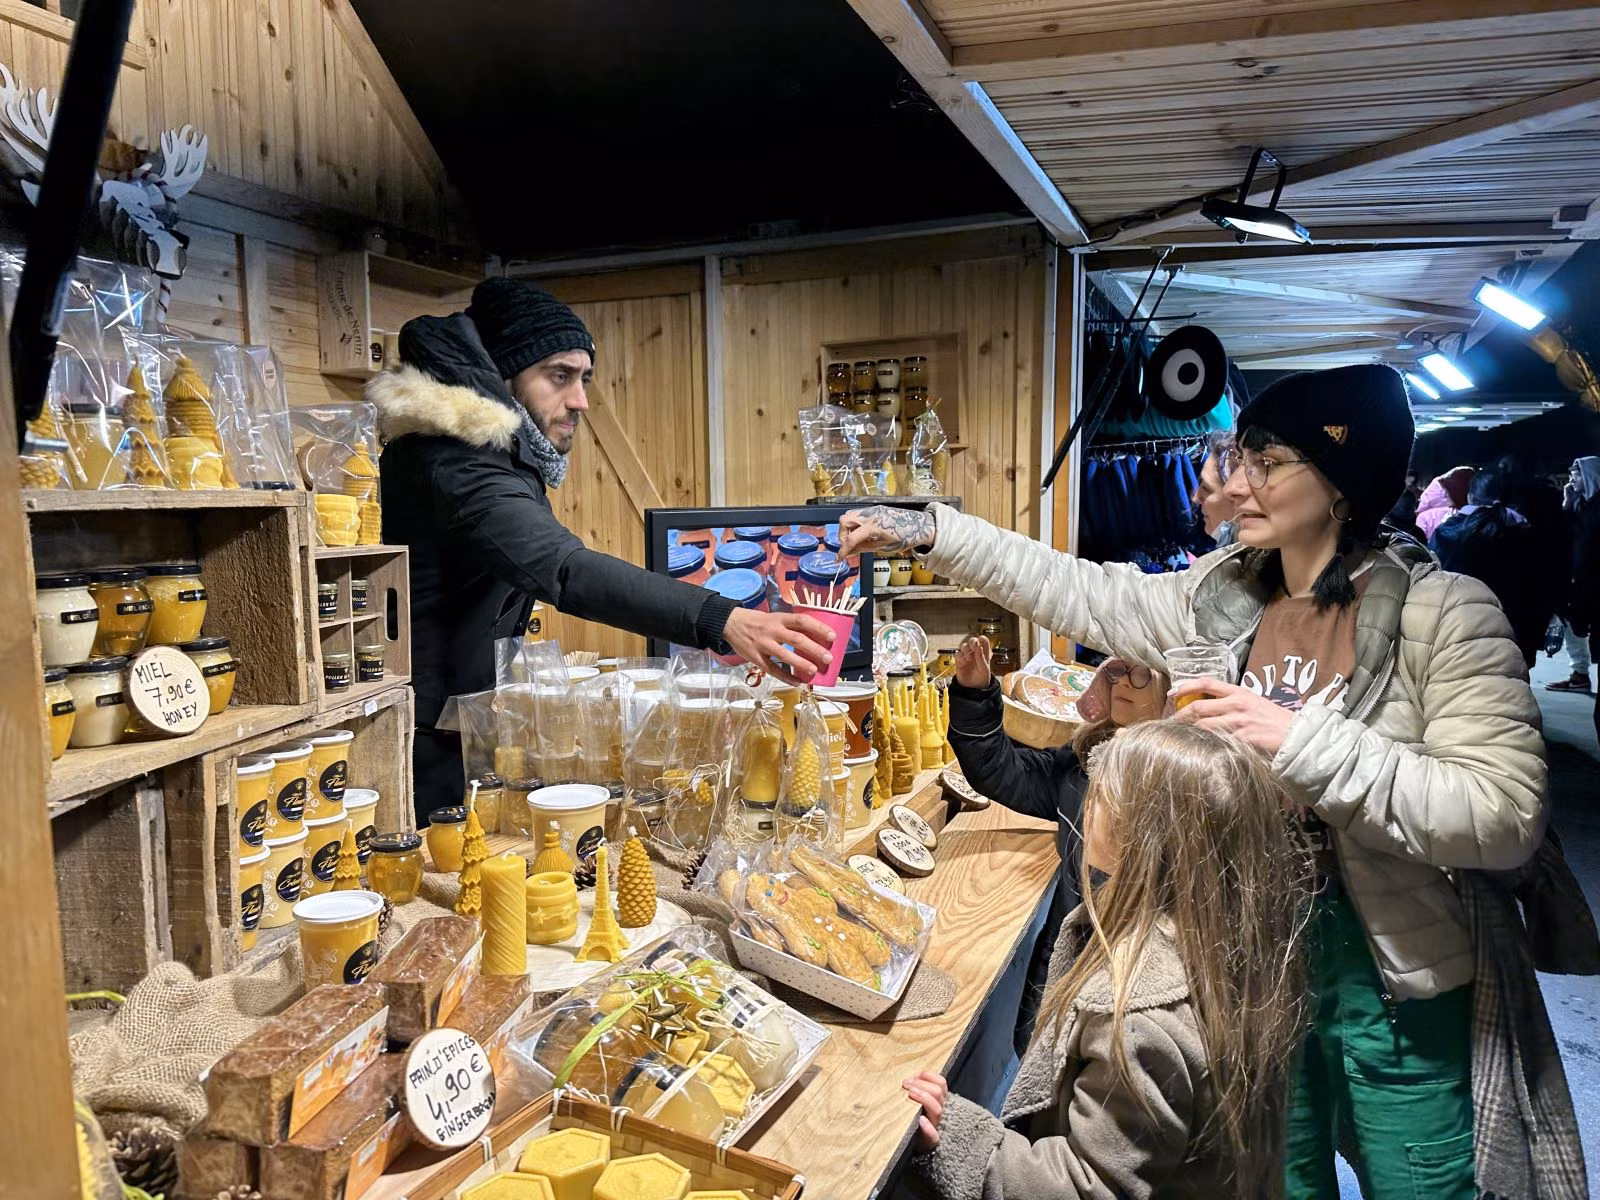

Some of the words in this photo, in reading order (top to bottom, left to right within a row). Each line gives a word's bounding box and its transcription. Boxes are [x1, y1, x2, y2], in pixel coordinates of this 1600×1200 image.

[135, 662, 173, 684] MIEL
[1282, 655, 1317, 695] TO
[162, 701, 198, 727] HONEY
[881, 833, 901, 844] MIEL
[856, 860, 879, 877] PACK
